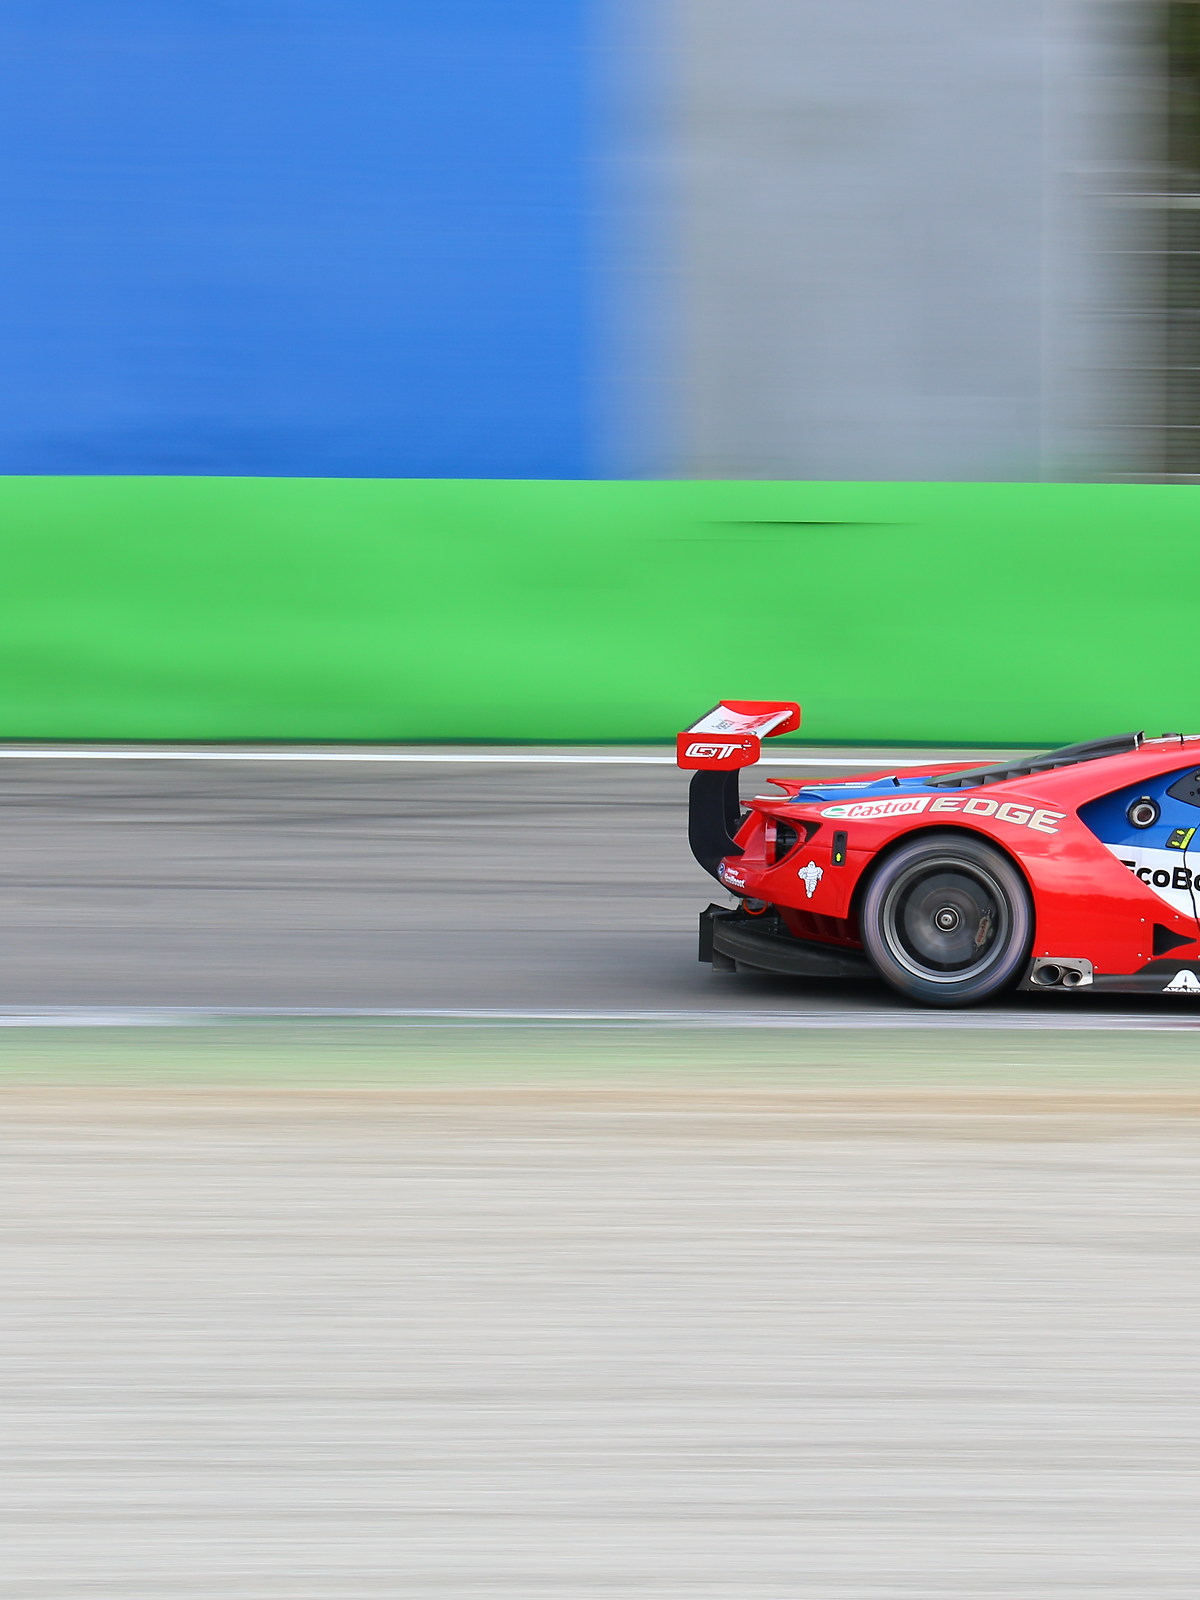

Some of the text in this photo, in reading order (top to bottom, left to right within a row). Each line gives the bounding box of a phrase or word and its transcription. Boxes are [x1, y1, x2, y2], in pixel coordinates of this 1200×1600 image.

[685, 743, 752, 759] GT
[847, 797, 1067, 834] Castrol EDGE
